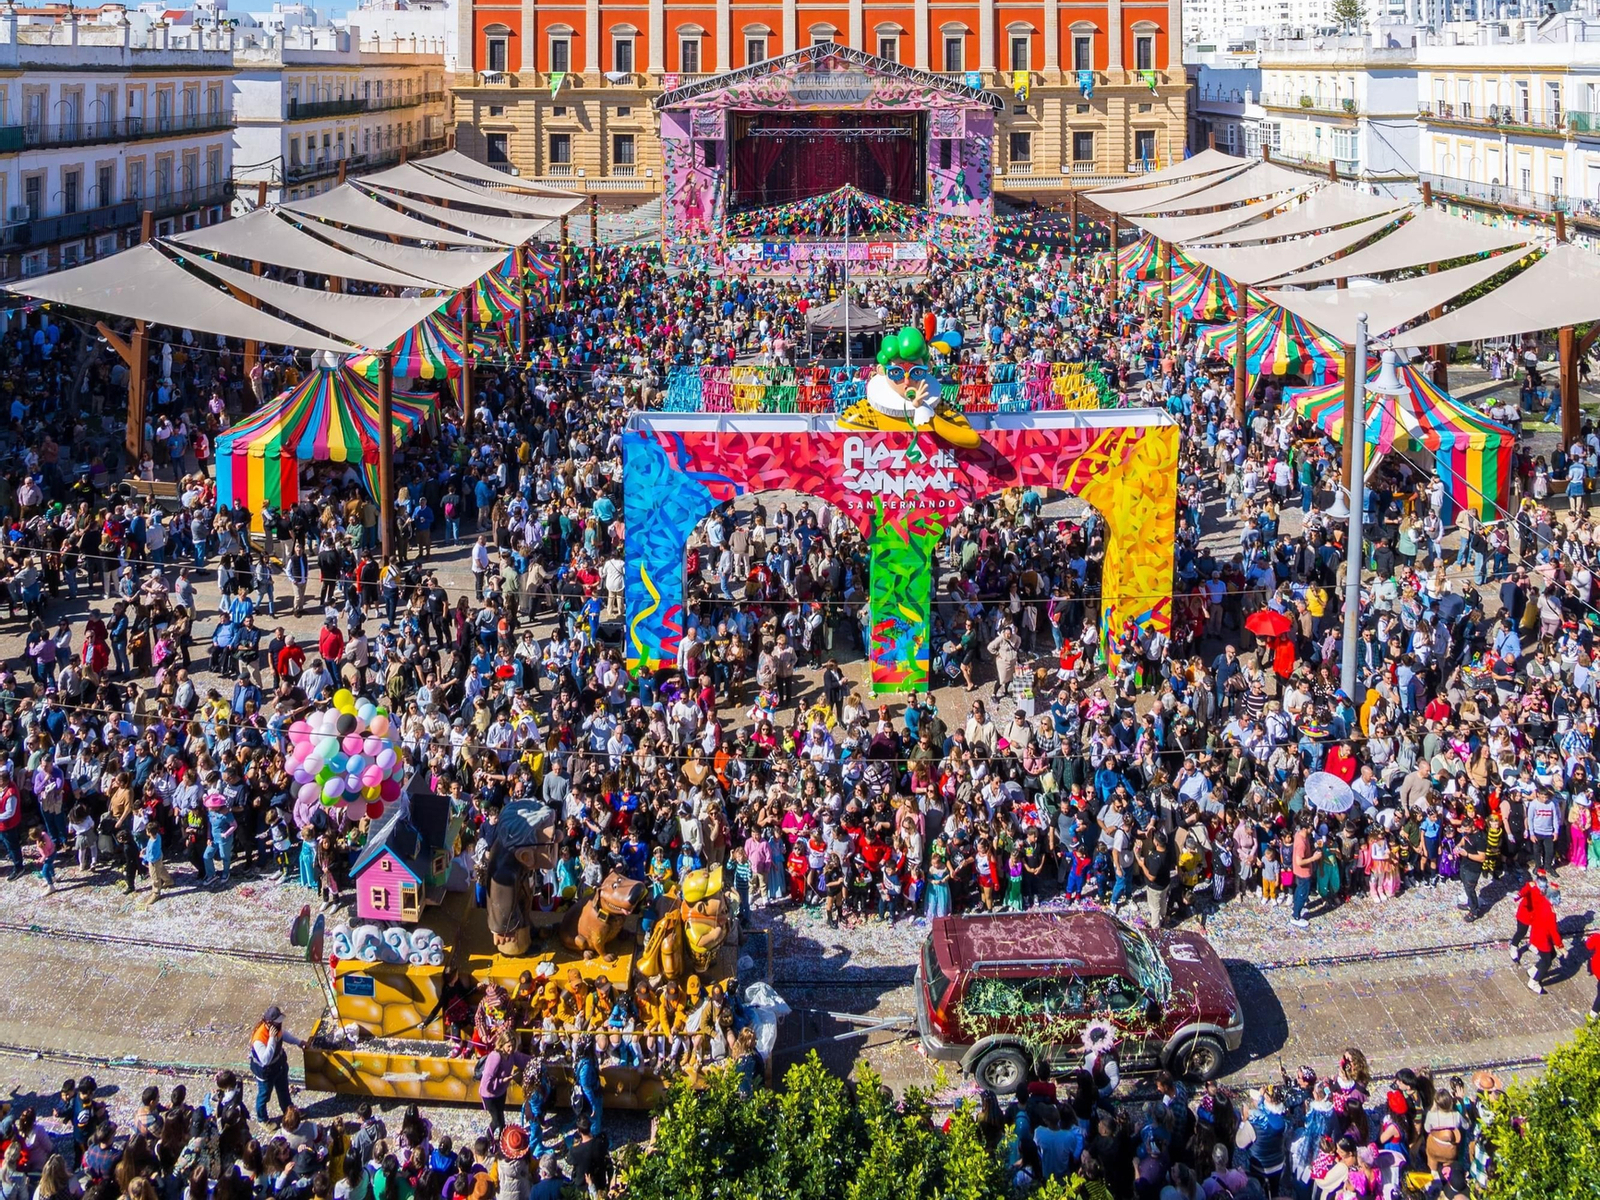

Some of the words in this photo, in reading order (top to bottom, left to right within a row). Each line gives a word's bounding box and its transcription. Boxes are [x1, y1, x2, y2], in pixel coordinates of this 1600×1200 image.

[797, 89, 862, 100] CARNAVAL
[848, 500, 874, 510] SAN
[882, 499, 956, 510] FERNANDO
